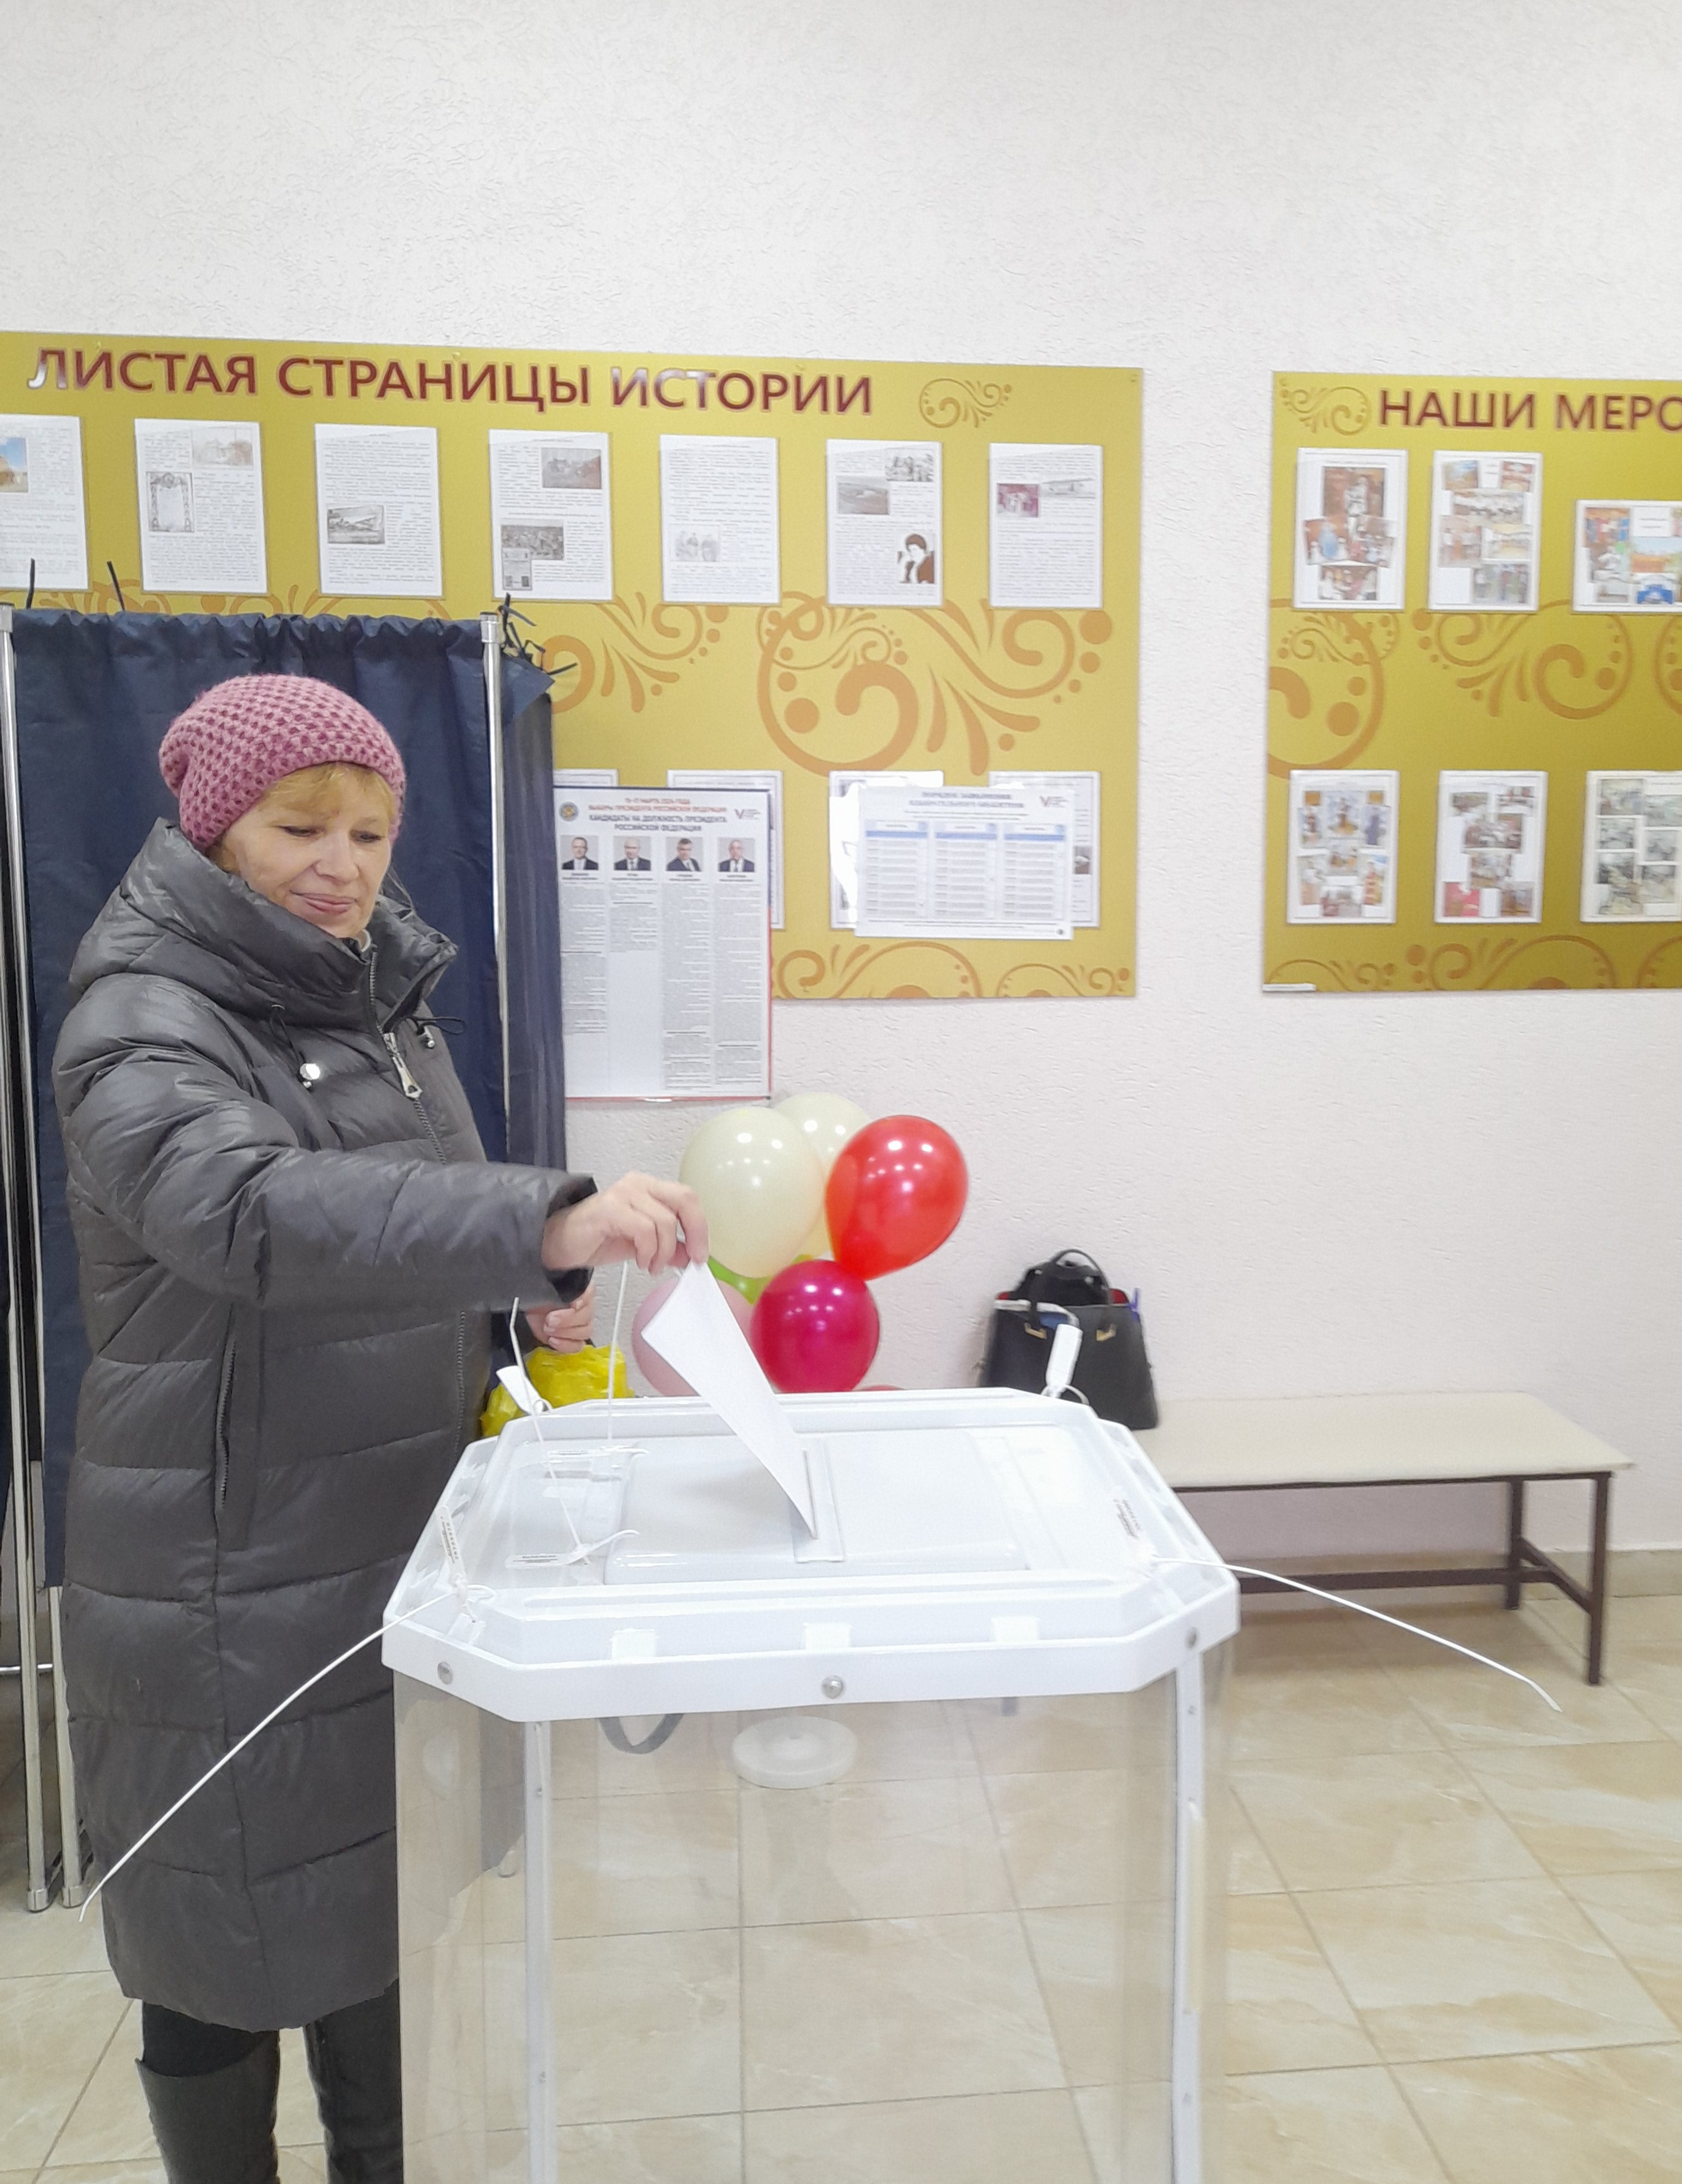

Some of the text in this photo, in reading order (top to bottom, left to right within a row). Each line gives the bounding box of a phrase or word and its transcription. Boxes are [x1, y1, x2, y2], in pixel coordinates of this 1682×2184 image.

[27, 349, 872, 414] ЛИСТАЯ СТРАНИЦЫ ИСТОРИИ
[1380, 390, 1535, 429] НАШИ
